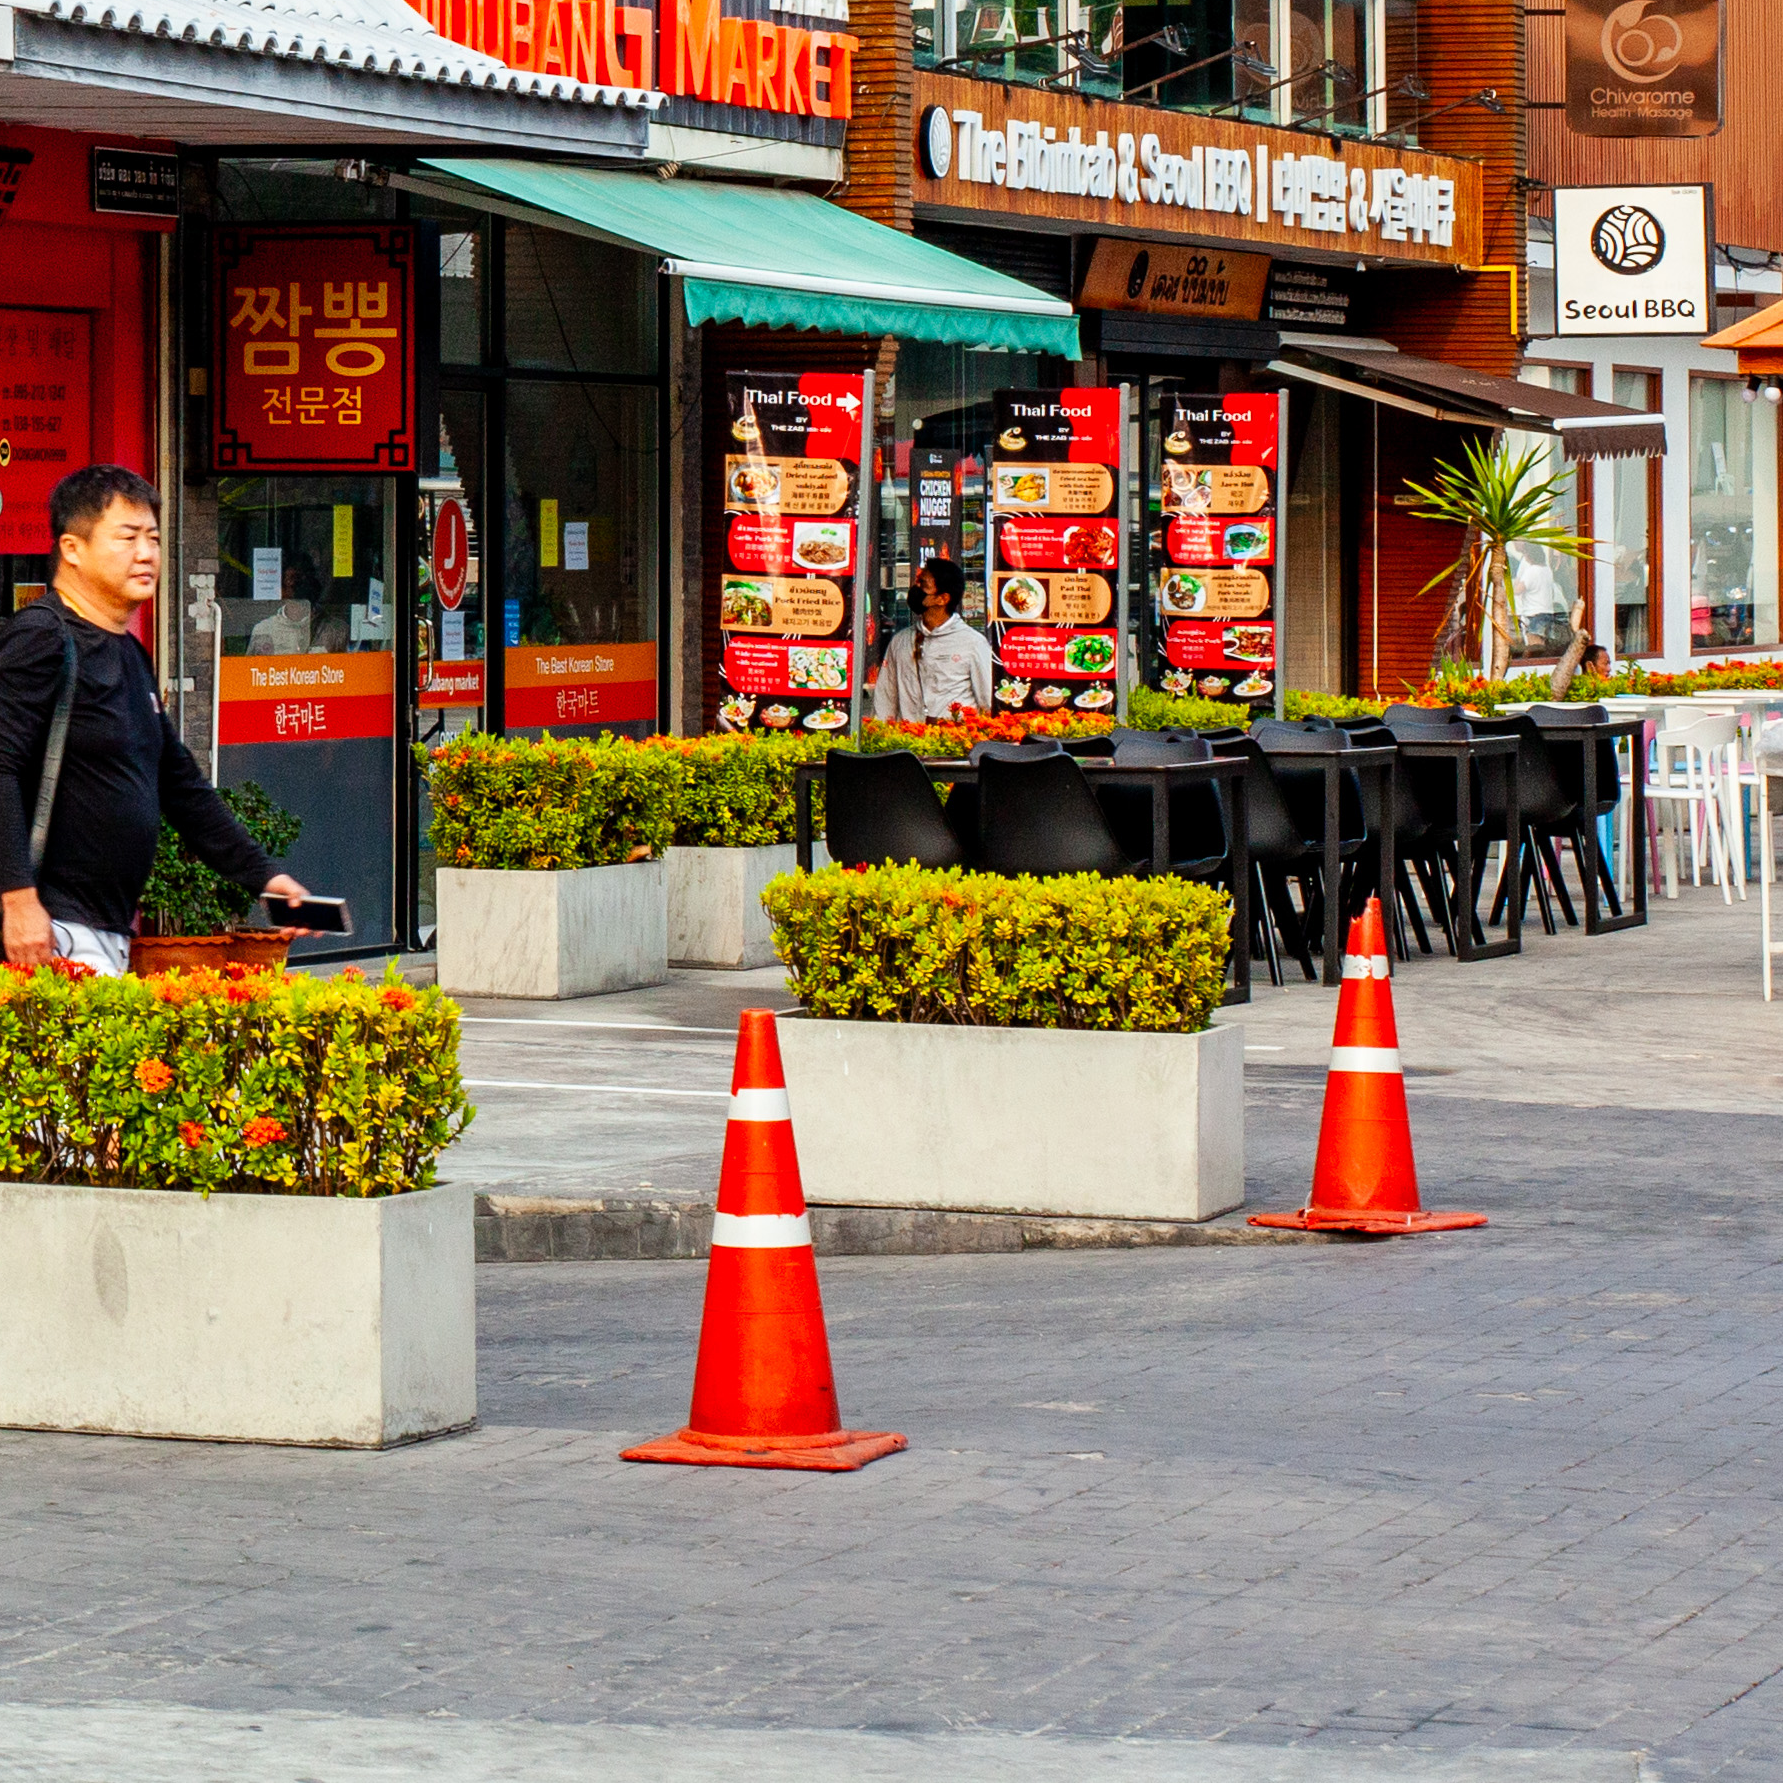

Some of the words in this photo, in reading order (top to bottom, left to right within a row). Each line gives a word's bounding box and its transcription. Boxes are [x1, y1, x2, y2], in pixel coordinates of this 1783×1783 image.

[1590, 87, 1695, 105] Chivarome
[1591, 106, 1632, 118] Health
[1637, 107, 1694, 121] Massage
[952, 109, 1007, 186] The
[1006, 119, 1117, 200] Bibimbab
[1117, 132, 1141, 204] &
[1140, 133, 1204, 211] Seoul
[1205, 146, 1253, 216] BBQ
[1565, 299, 1637, 320] Seoul
[1645, 298, 1696, 319] BBQ
[230, 281, 398, 377] 짬뽕
[262, 385, 364, 426] 전문점
[746, 389, 783, 405] Thai
[787, 390, 832, 406] Food
[795, 416, 809, 424] BY
[1010, 403, 1046, 417] Thai
[1049, 404, 1092, 418] Food
[1175, 408, 1209, 422] Thai
[1212, 409, 1252, 423] Food
[920, 479, 952, 496] CHICKEN
[919, 497, 952, 517] NUGGET
[774, 597, 795, 605] Pork
[797, 597, 821, 606] Fried
[821, 598, 842, 606] Rice
[535, 658, 550, 675] The
[550, 657, 568, 674] Best
[568, 656, 594, 674] Korean
[594, 655, 615, 673] Store
[250, 667, 268, 688] The
[268, 667, 289, 687] Best
[289, 666, 321, 686] Korean
[321, 666, 345, 685] Store
[455, 673, 480, 691] market
[556, 687, 600, 719] 한국마트
[274, 700, 327, 736] 한국마트
